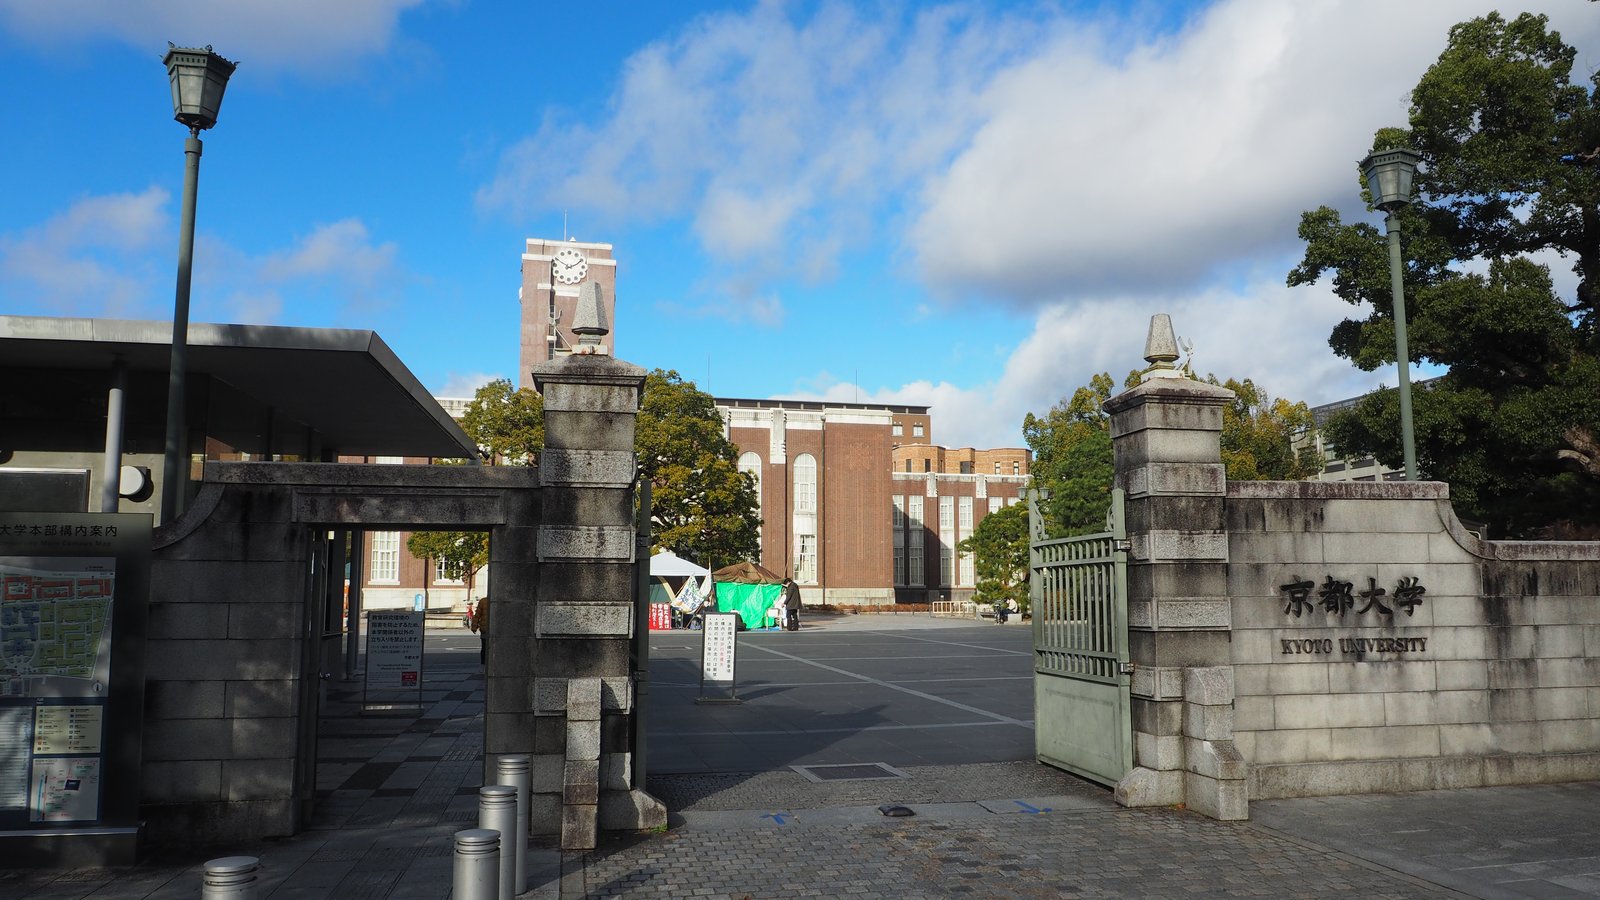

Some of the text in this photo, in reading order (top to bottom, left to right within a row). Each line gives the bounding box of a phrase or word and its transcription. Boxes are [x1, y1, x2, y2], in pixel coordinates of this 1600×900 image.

[0, 525, 118, 537] 大学本部構内案内
[1279, 574, 1426, 618] 京都大学
[1281, 637, 1428, 655] KYOTO UNIVERSITY
